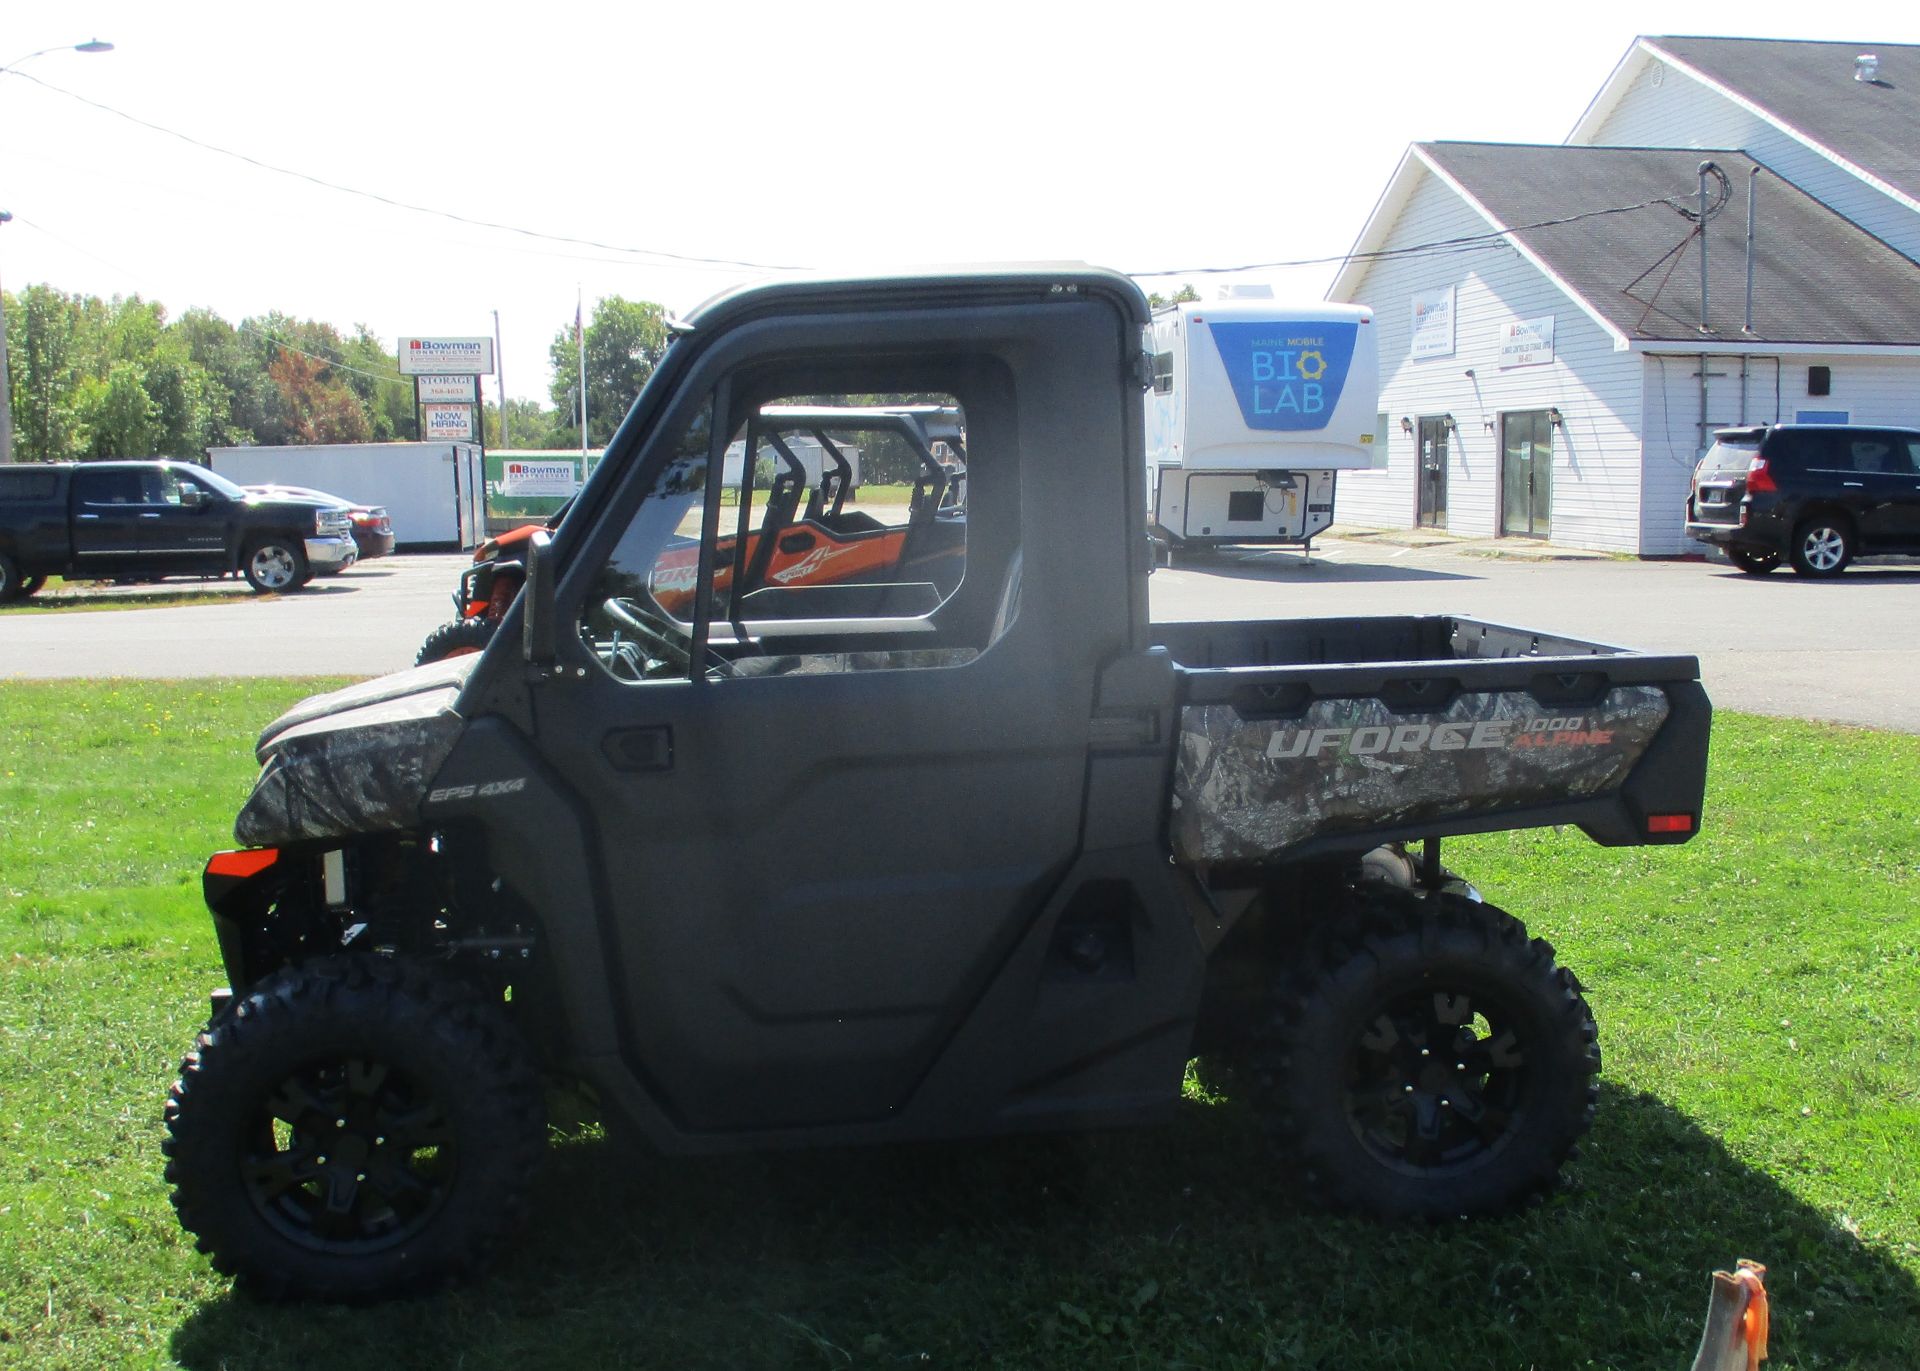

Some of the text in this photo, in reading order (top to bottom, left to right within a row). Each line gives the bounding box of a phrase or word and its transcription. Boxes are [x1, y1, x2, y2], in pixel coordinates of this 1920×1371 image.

[422, 341, 481, 350] Bowman
[1252, 338, 1324, 347] MAINE MOBILE
[421, 376, 472, 384] STORAGE
[1254, 383, 1325, 414] LAB
[1267, 717, 1583, 758] UFORCE 1000
[1513, 731, 1615, 747] ALPINE
[429, 785, 477, 802] EPS
